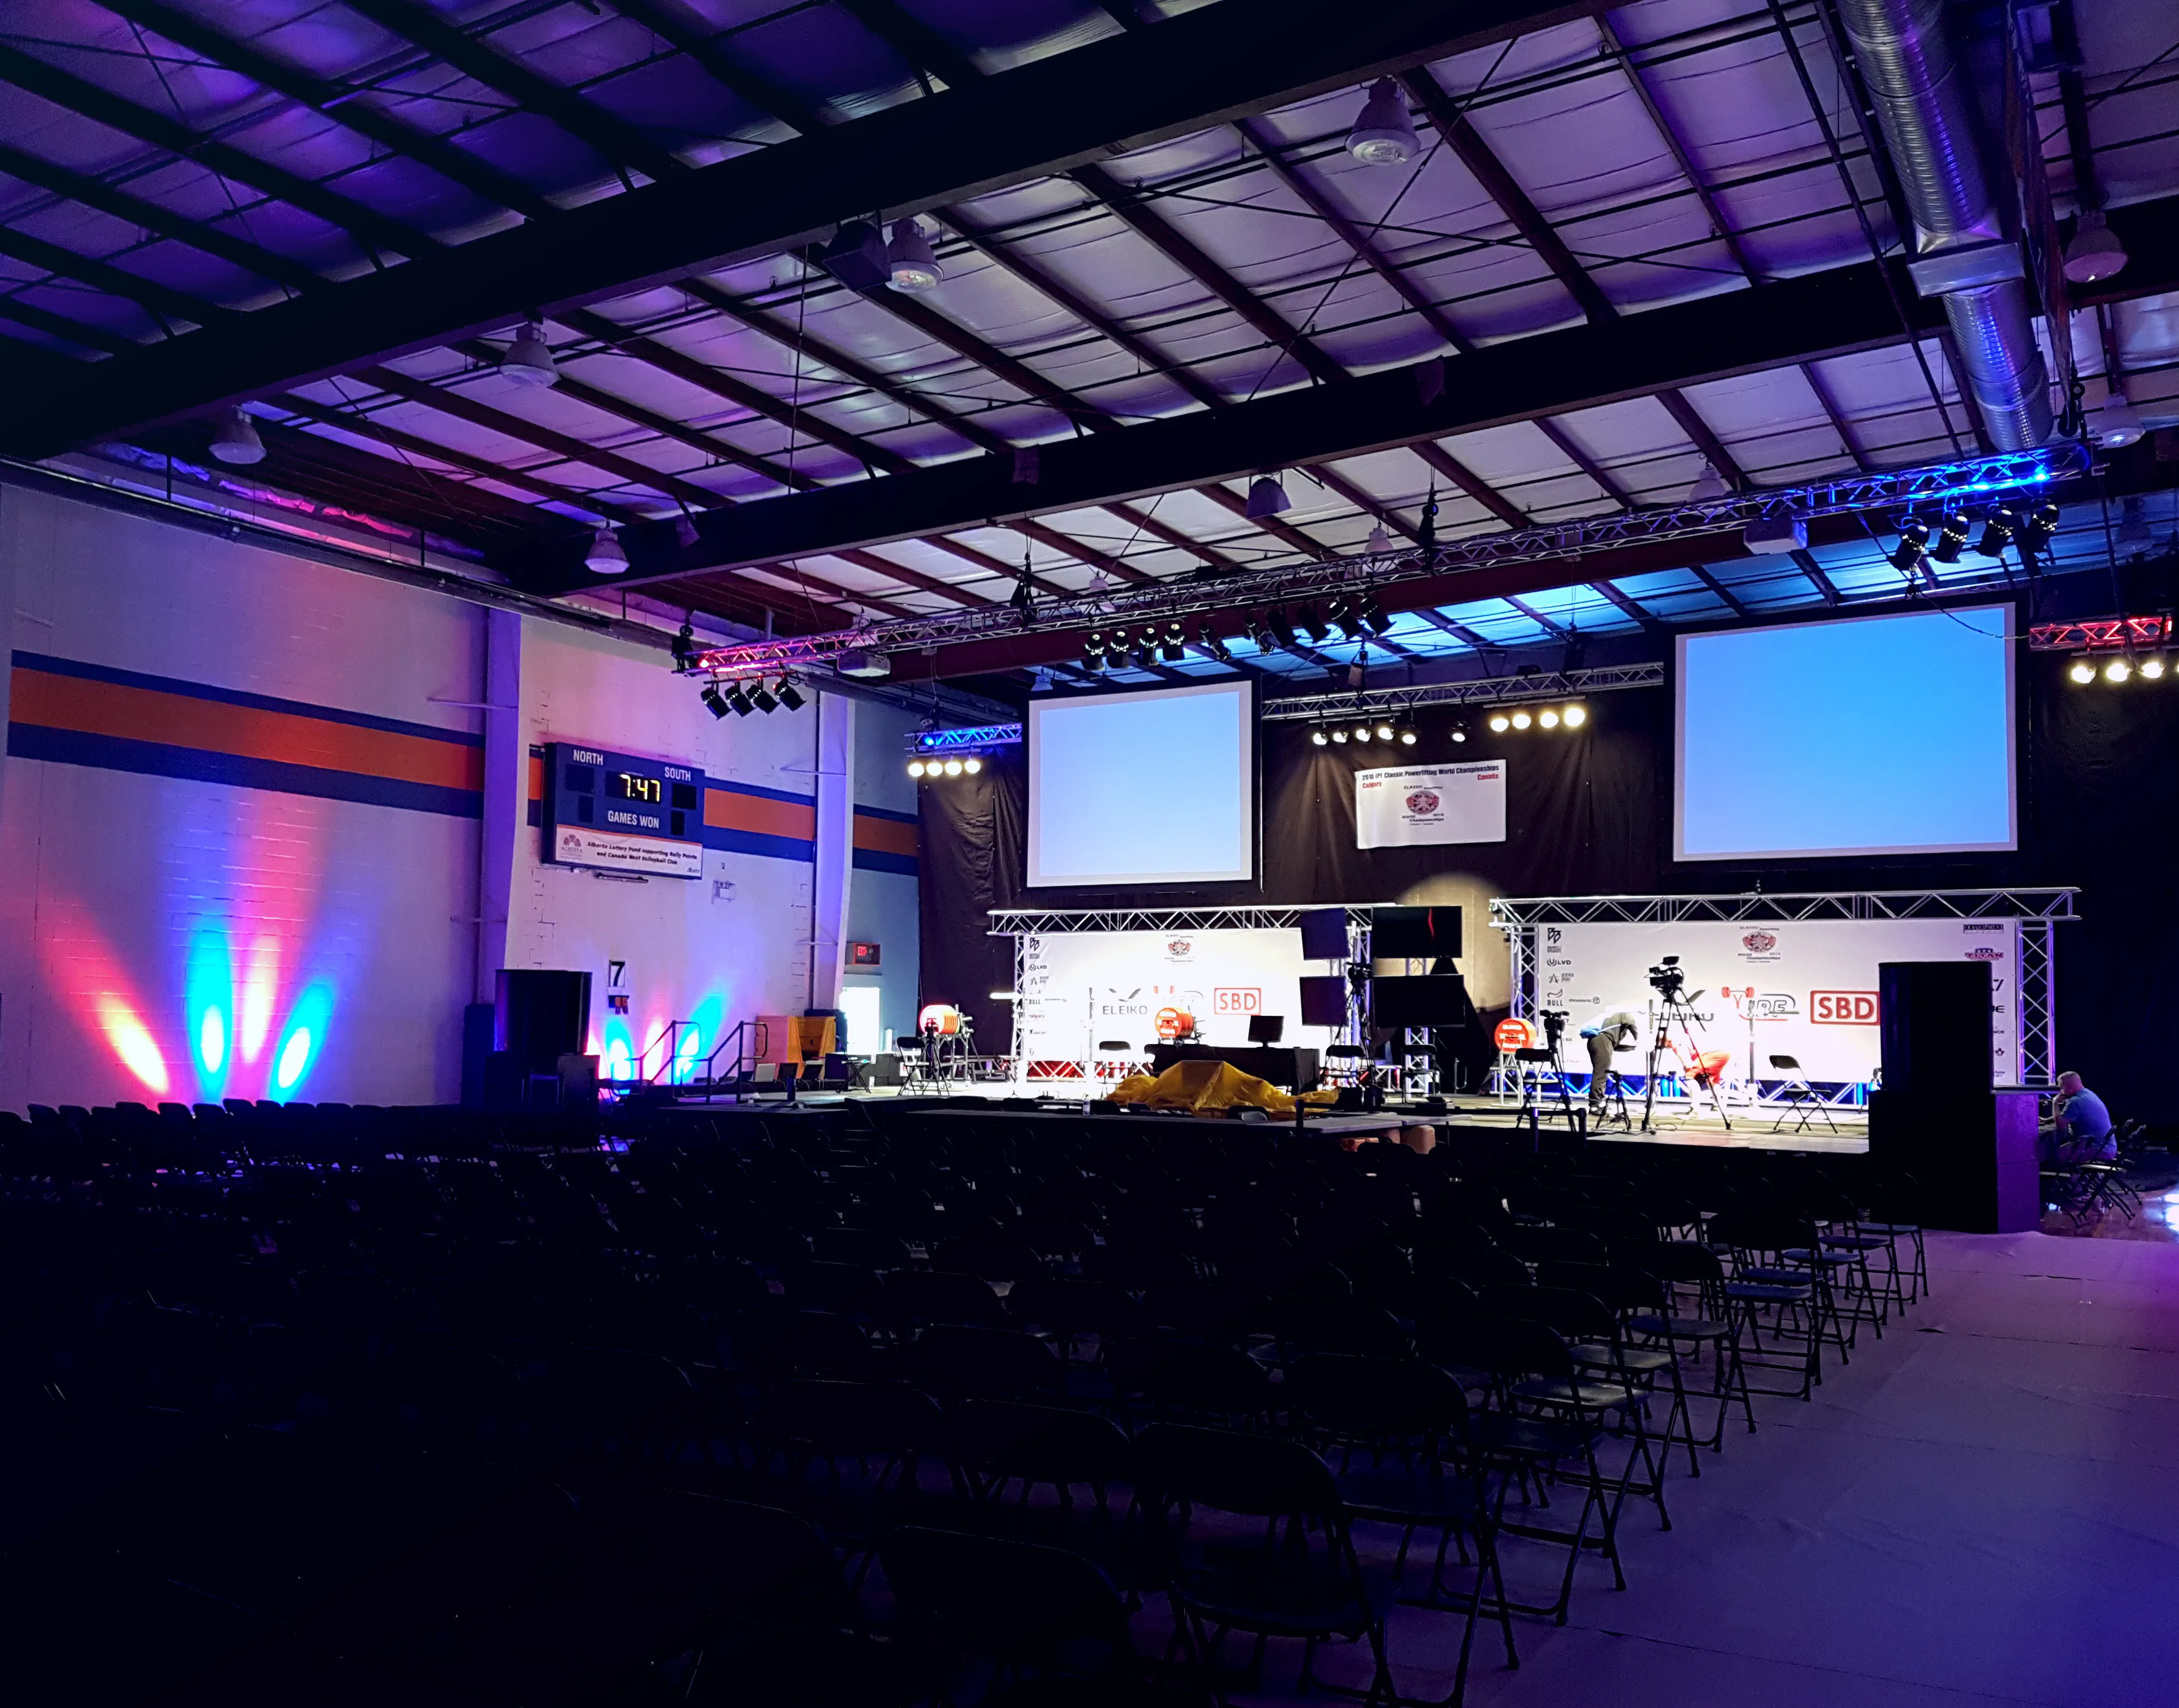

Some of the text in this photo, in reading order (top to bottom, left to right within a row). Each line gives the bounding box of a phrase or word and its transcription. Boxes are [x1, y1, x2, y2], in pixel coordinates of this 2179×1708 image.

[573, 749, 603, 766] NORTH
[664, 766, 692, 782] SOUTH
[1405, 769, 1438, 777] Powerlifting
[1456, 765, 1499, 774] Championships
[619, 774, 661, 802] 7:47
[608, 810, 660, 828] GAMES WON
[609, 844, 627, 852] Lottery
[642, 848, 668, 857] supporting
[611, 961, 625, 987] 7
[1103, 1005, 1147, 1015] ELEIKO
[1220, 993, 1257, 1011] SBD
[1819, 997, 1875, 1019] SBD
